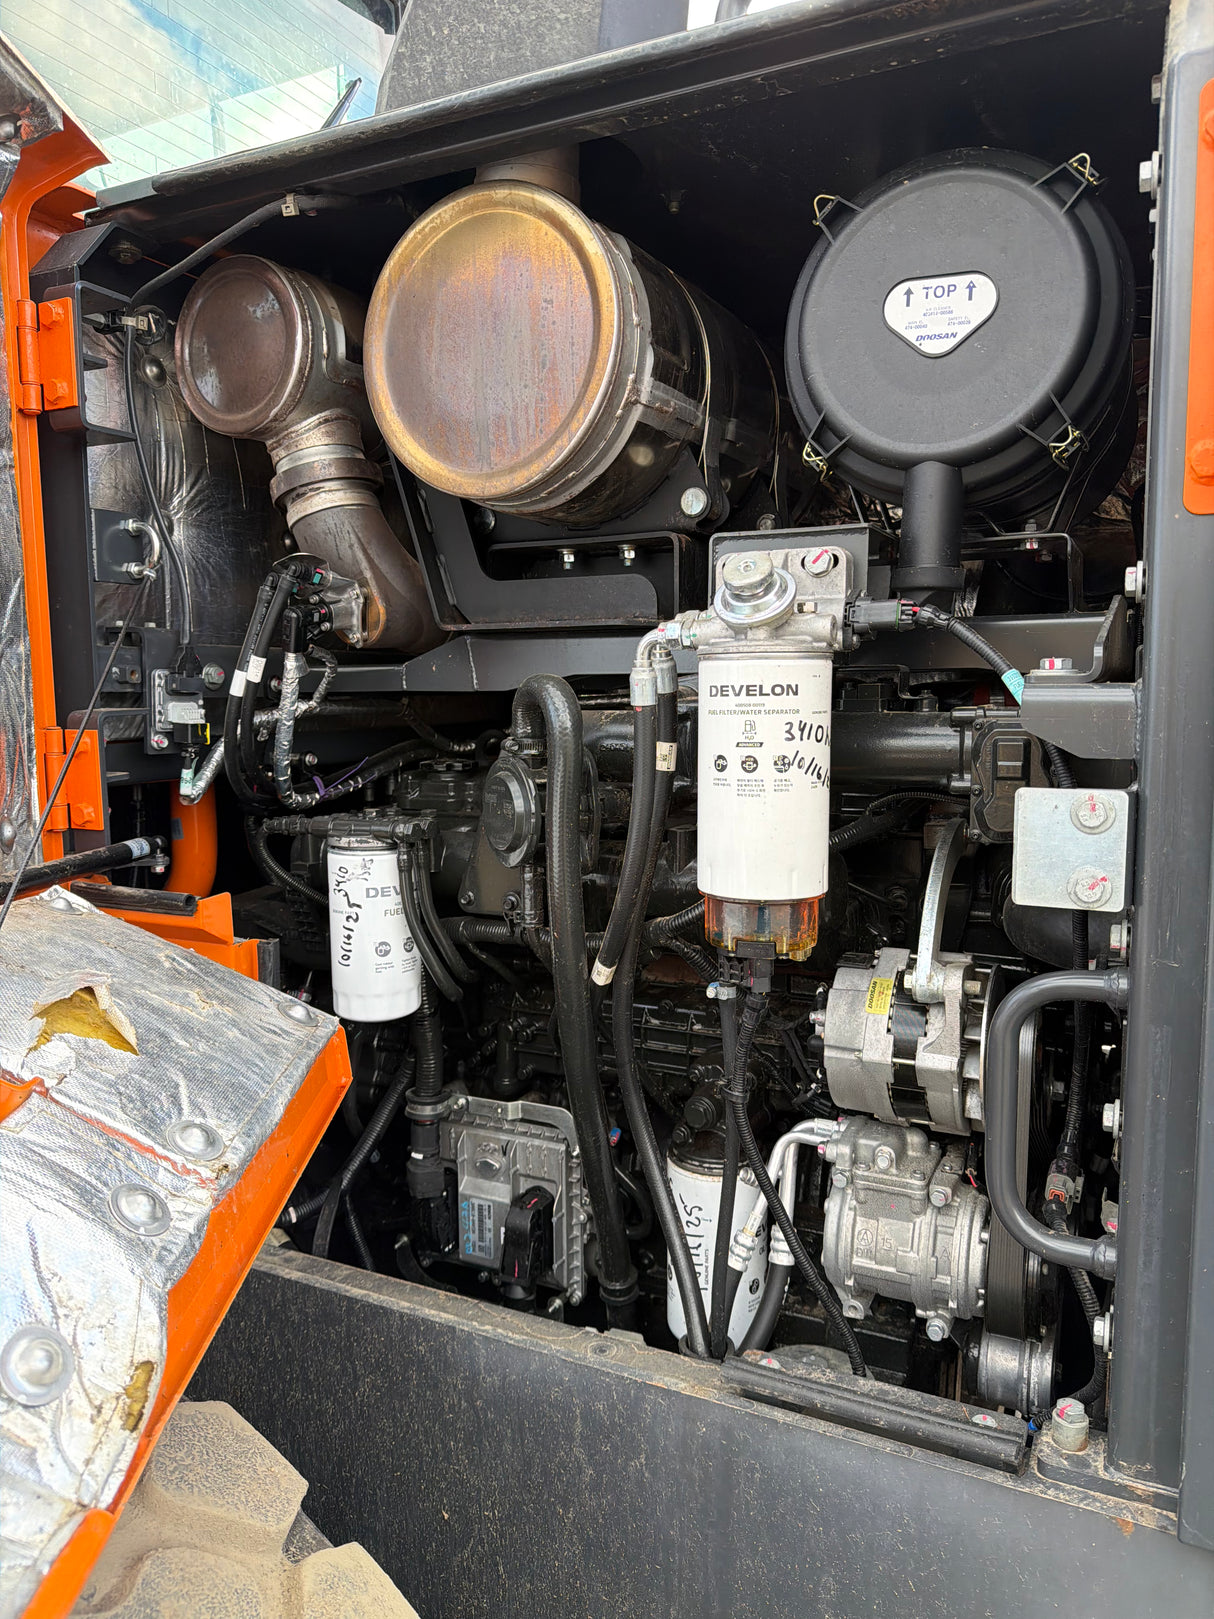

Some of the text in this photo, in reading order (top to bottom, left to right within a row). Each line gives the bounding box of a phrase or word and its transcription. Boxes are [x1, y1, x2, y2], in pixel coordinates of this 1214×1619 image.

[922, 284, 957, 299] TOP
[915, 332, 958, 341] DOOSAN
[709, 684, 799, 698] DEVELON
[763, 708, 801, 716] SEPARATOR
[384, 906, 404, 915] FUEL
[867, 980, 878, 1010] DOOSAN
[880, 1236, 893, 1249] 15
